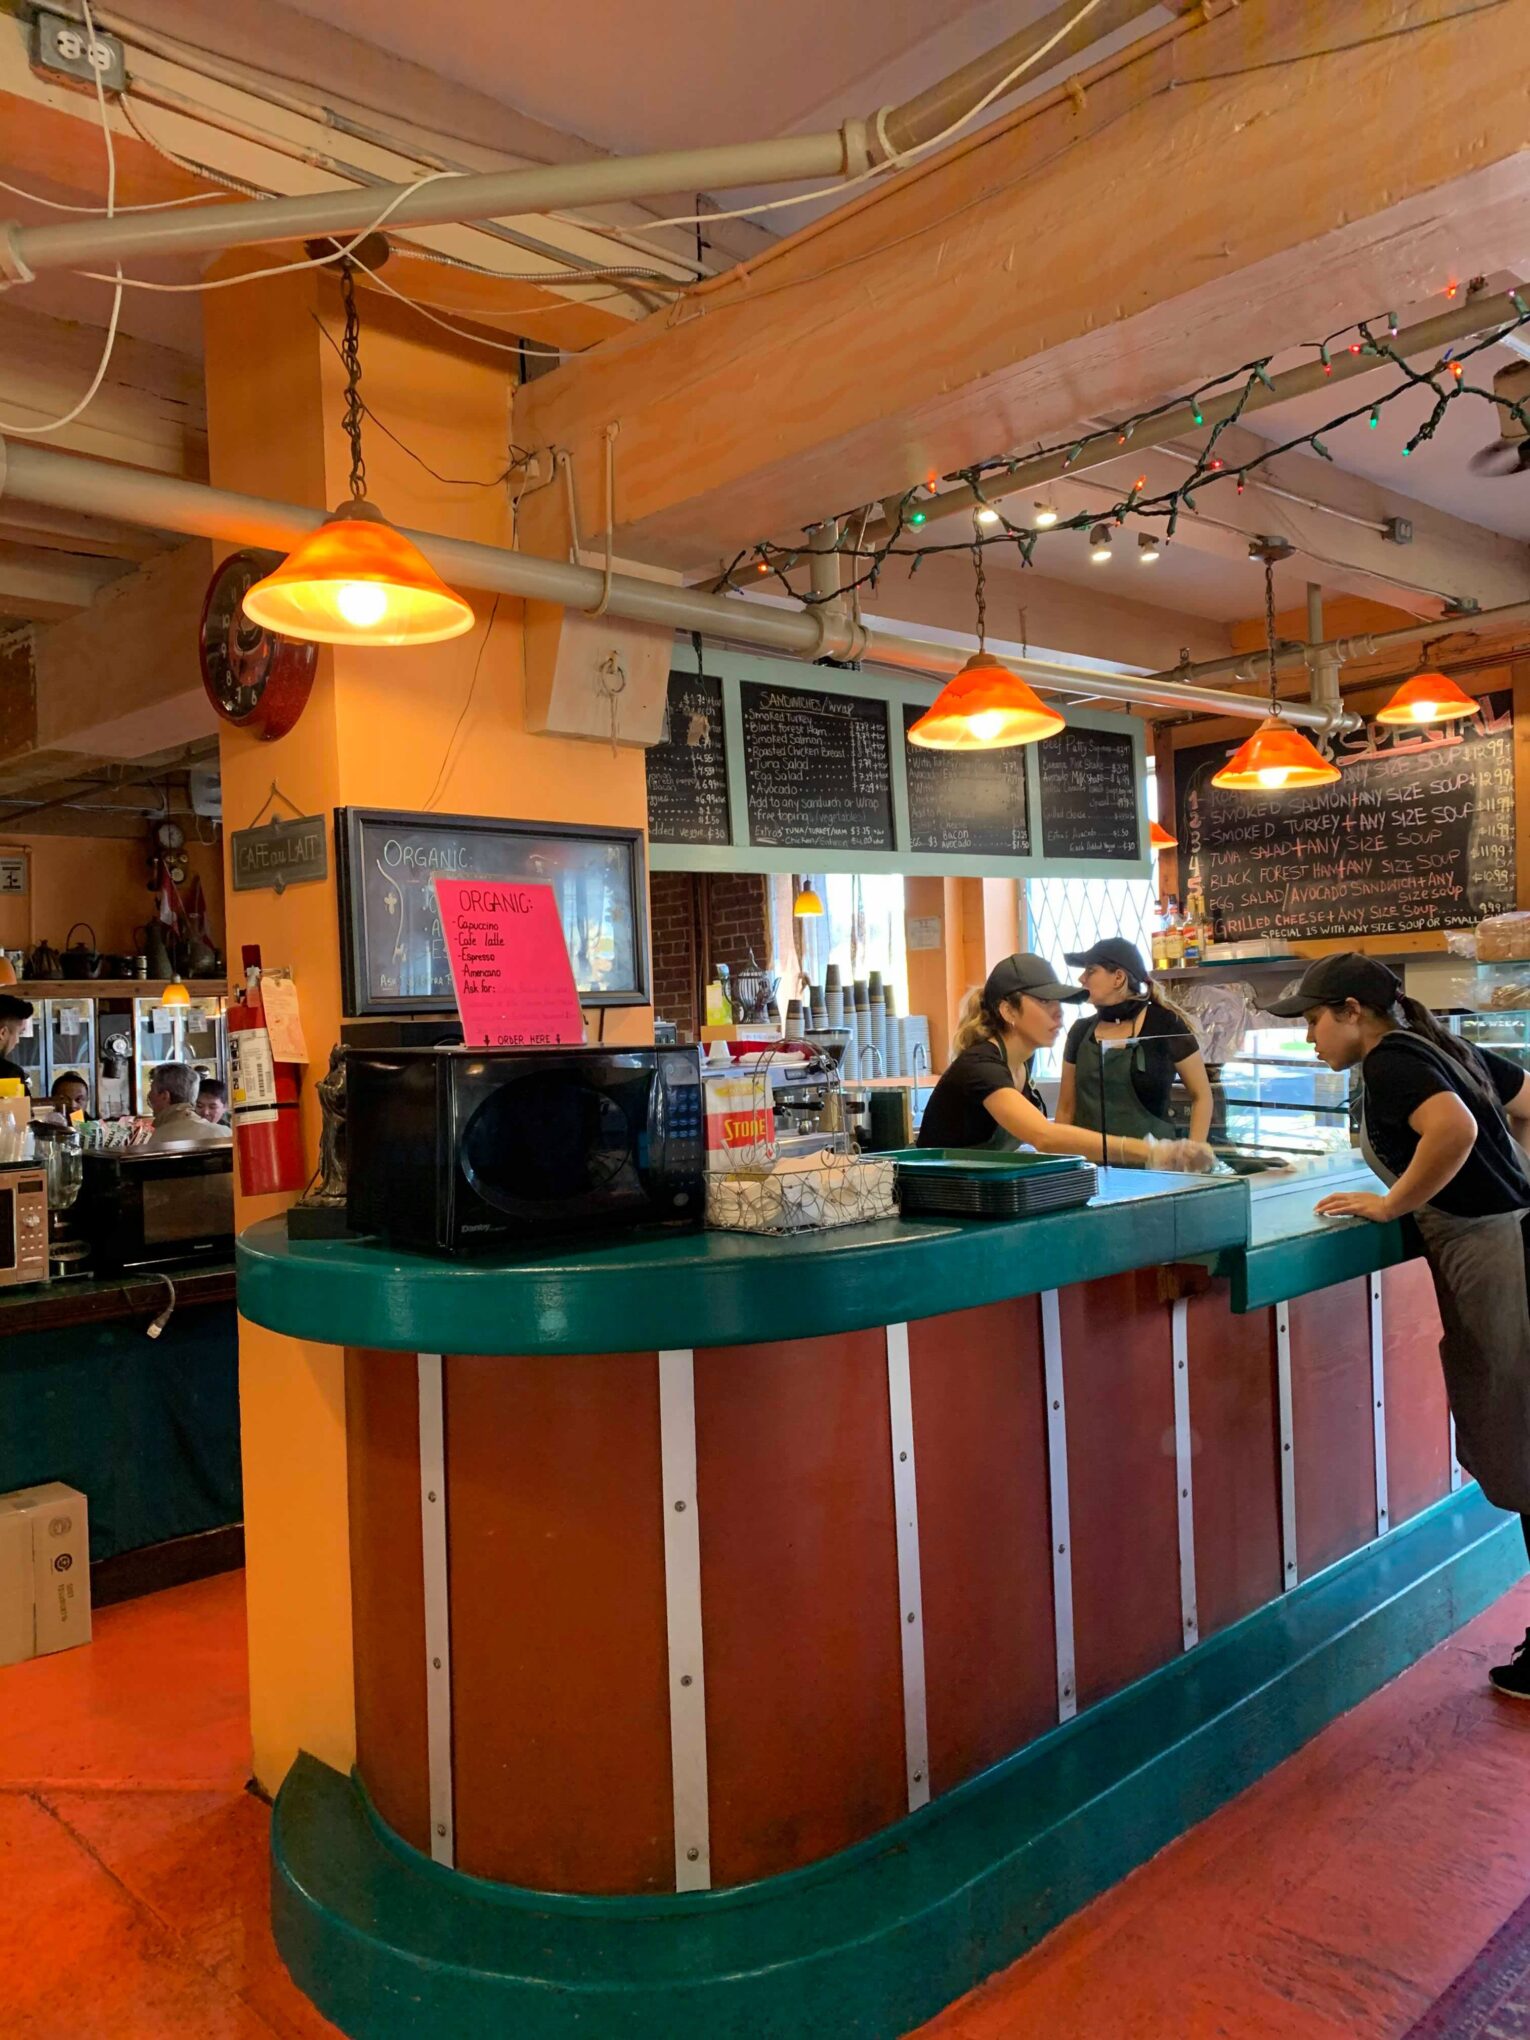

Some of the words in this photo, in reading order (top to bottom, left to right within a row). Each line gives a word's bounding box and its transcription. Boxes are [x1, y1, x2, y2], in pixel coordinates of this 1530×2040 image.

[222, 614, 230, 629] 10
[221, 643, 227, 659] 9
[226, 670, 232, 686] 8
[251, 689, 257, 705] 6
[749, 708, 785, 721] Smoked
[787, 712, 813, 728] Turkey
[750, 721, 777, 733] Black
[807, 725, 828, 736] Ham
[752, 733, 787, 744] Smoked
[789, 734, 823, 746] Salmon
[1066, 735, 1088, 757] Patty
[753, 745, 786, 757] Roasted
[787, 746, 820, 759] Chicken
[821, 748, 845, 758] Breast
[754, 758, 780, 769] Tuna
[782, 758, 809, 770] Salad
[1343, 768, 1369, 787] ANY
[1374, 758, 1411, 777] SIZE
[1412, 747, 1462, 774] SOUP
[754, 770, 774, 785] Egg
[774, 770, 804, 780] Salad
[756, 782, 798, 795] Avocado
[749, 795, 768, 808] Add
[771, 796, 780, 807] to
[782, 800, 799, 811] any
[844, 800, 853, 808] or
[1210, 801, 1281, 825] SMOKED
[1288, 793, 1351, 814] SALMON
[1387, 782, 1426, 802] SIZE
[1430, 773, 1470, 794] SOUP
[1210, 822, 1275, 846] SMOKED
[1283, 814, 1341, 835] TURKEY
[1360, 810, 1386, 831] ANY
[1391, 807, 1428, 828] SIZE
[270, 850, 287, 866] au
[287, 834, 319, 863] LAIT
[1210, 850, 1241, 868] TUNA
[1249, 841, 1292, 860] SALAD
[1307, 836, 1341, 858] ANY
[1346, 834, 1389, 852] SIZE
[1397, 829, 1443, 846] SOUP
[1210, 867, 1253, 892] BLACK
[1260, 865, 1310, 883] FOREST
[1381, 859, 1415, 874] SIZE
[1416, 849, 1461, 869] SOUP
[1209, 895, 1235, 912] EGG
[1350, 877, 1417, 897] SANDWICH
[1428, 871, 1455, 888] ANY
[459, 890, 534, 914] ORGANIC:
[1214, 914, 1271, 940] GRILLED
[1338, 906, 1365, 925] ANY
[1370, 905, 1400, 920] SIZE
[1261, 926, 1302, 941] SPECIAL
[1320, 924, 1346, 935] WITH
[1348, 923, 1369, 934] ANY
[1370, 921, 1398, 933] SIZE
[1398, 919, 1427, 931] SOUP
[1427, 916, 1442, 928] OR
[1445, 914, 1481, 926] SMALL
[484, 932, 506, 947] latte
[463, 979, 480, 995] Ask
[481, 979, 497, 994] for:
[497, 1034, 525, 1046] ORDER
[529, 1034, 552, 1045] HERE
